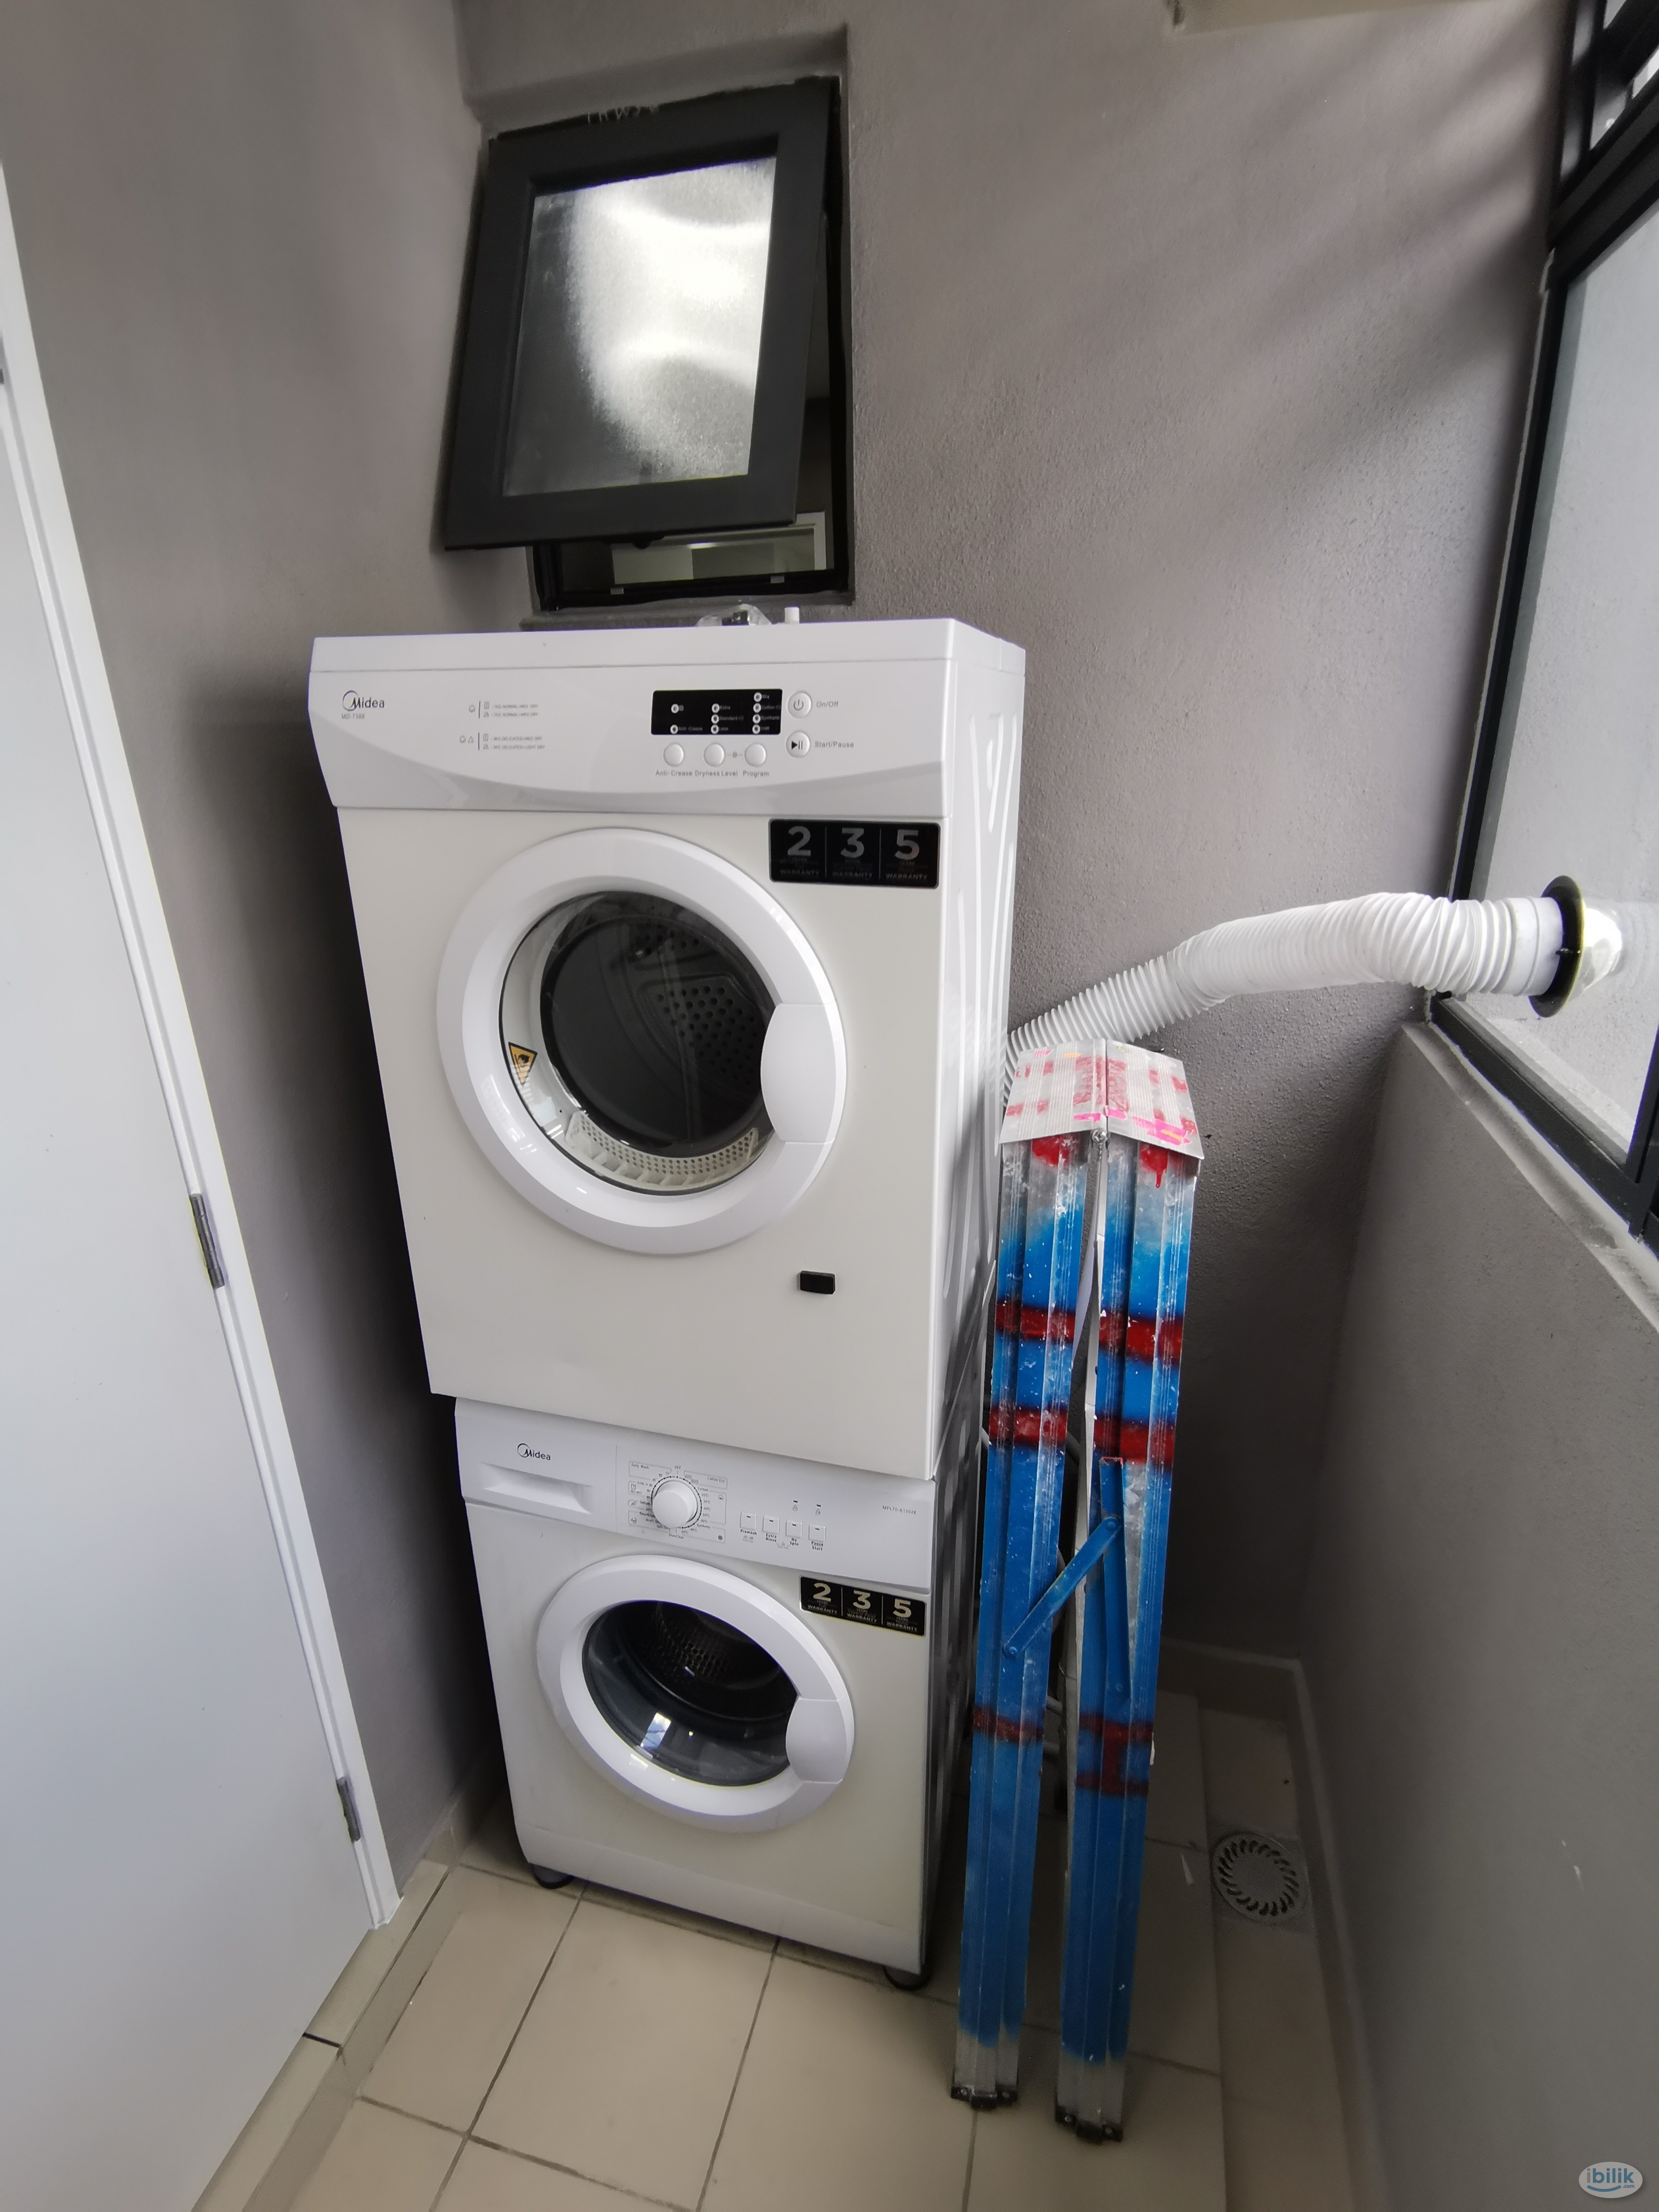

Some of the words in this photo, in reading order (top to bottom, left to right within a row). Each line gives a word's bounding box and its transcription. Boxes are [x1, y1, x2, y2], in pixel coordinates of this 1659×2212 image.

[342, 690, 385, 711] Midea
[695, 769, 720, 778] Dryness
[742, 770, 770, 778] Program
[787, 826, 811, 856] 2
[840, 828, 865, 858] 3
[895, 829, 920, 860] 5
[517, 1443, 551, 1460] Midea
[813, 1583, 831, 1602] 2
[853, 1589, 871, 1609] 3
[892, 1598, 912, 1618] 5
[807, 1604, 837, 1614] WARRANTY
[847, 1612, 877, 1623] WARRANTY
[886, 1621, 918, 1632] WARRANTY
